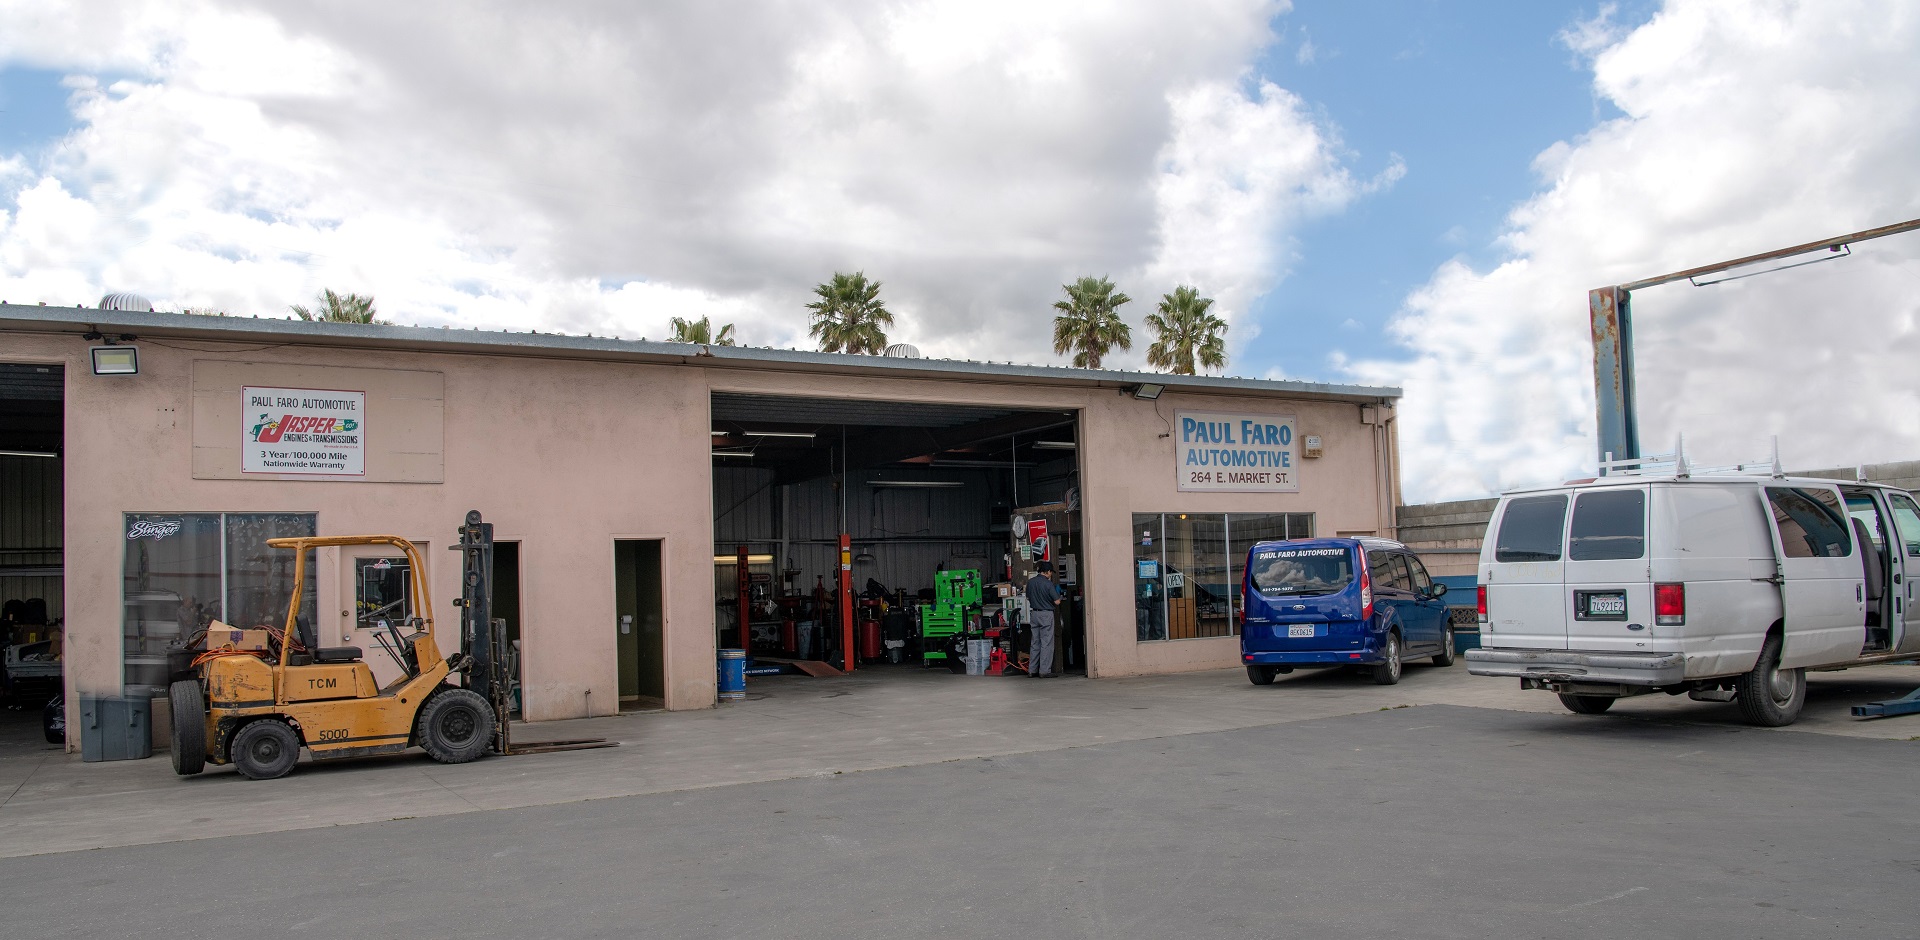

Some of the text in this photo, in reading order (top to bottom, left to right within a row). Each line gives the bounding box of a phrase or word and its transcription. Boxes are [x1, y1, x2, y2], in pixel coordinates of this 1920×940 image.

[252, 396, 356, 410] PAUL FARO AUTOMOTIVE
[259, 415, 336, 443] JASPER
[1183, 418, 1292, 446] PAUL FARO
[284, 433, 308, 443] ENGINES
[312, 434, 358, 444] TRANSMISSIONS
[269, 451, 326, 460] Year/100,000
[329, 452, 347, 460] Mile
[1186, 449, 1290, 467] AUTOMOTIVE
[263, 460, 345, 470] Nationwide Warranty
[1191, 472, 1289, 484] 264 E. MARKET ST.
[128, 521, 180, 540] Stinger
[1260, 552, 1277, 560] PAUL
[1297, 549, 1345, 557] AUTOMOTIVE
[1168, 574, 1182, 586] OPEN
[1592, 602, 1623, 612] 74921E2
[308, 678, 337, 689] TCM
[320, 729, 349, 740] 5000
